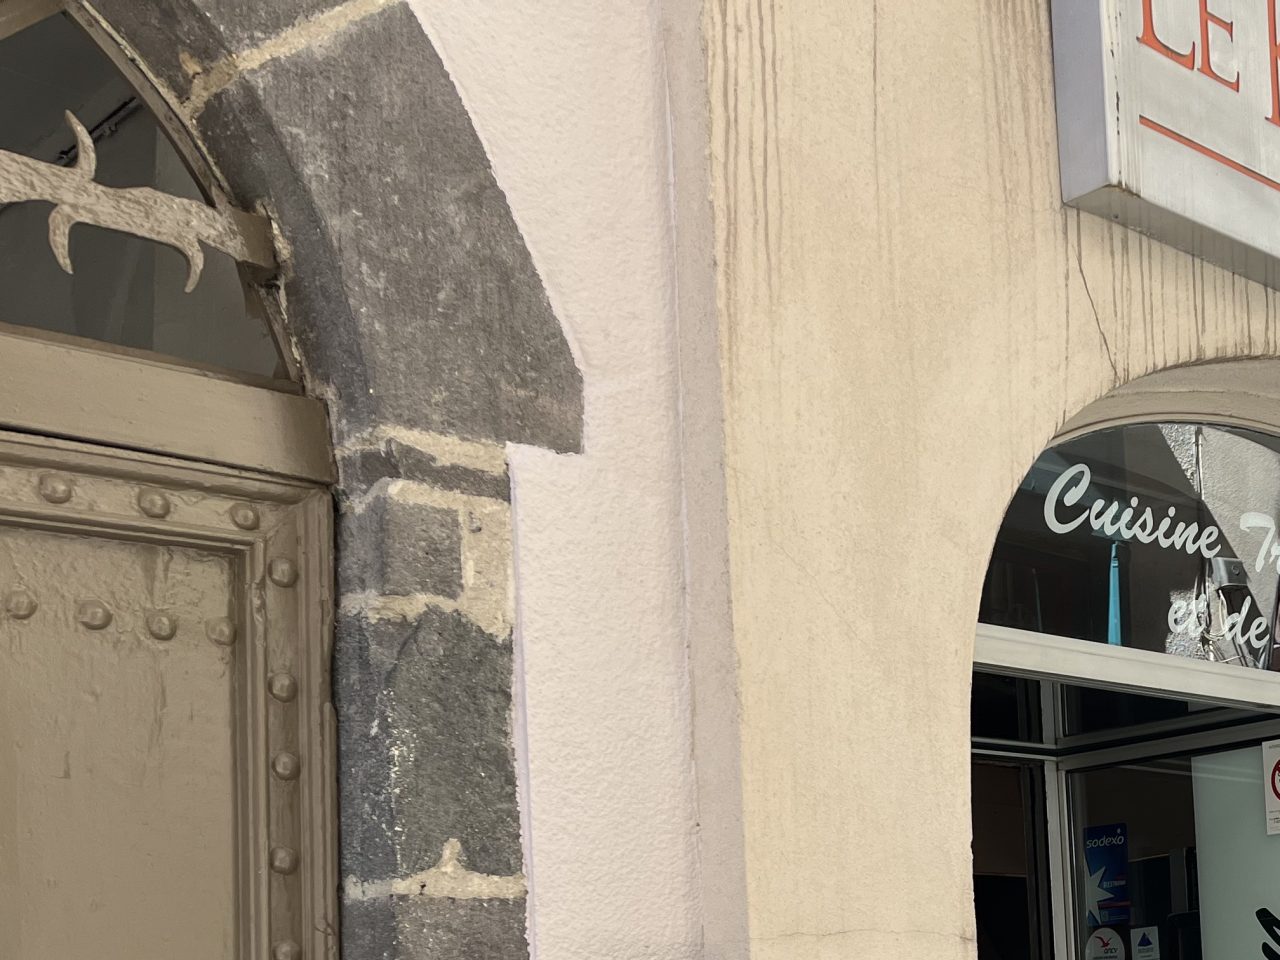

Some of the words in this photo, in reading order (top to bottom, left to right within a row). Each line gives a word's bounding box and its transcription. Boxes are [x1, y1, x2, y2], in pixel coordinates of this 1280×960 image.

[1136, 0, 1240, 92] LE
[1044, 463, 1221, 558] Cuisine
[1167, 582, 1208, 637] et
[1224, 596, 1270, 649] de
[1086, 834, 1125, 849] sodexo
